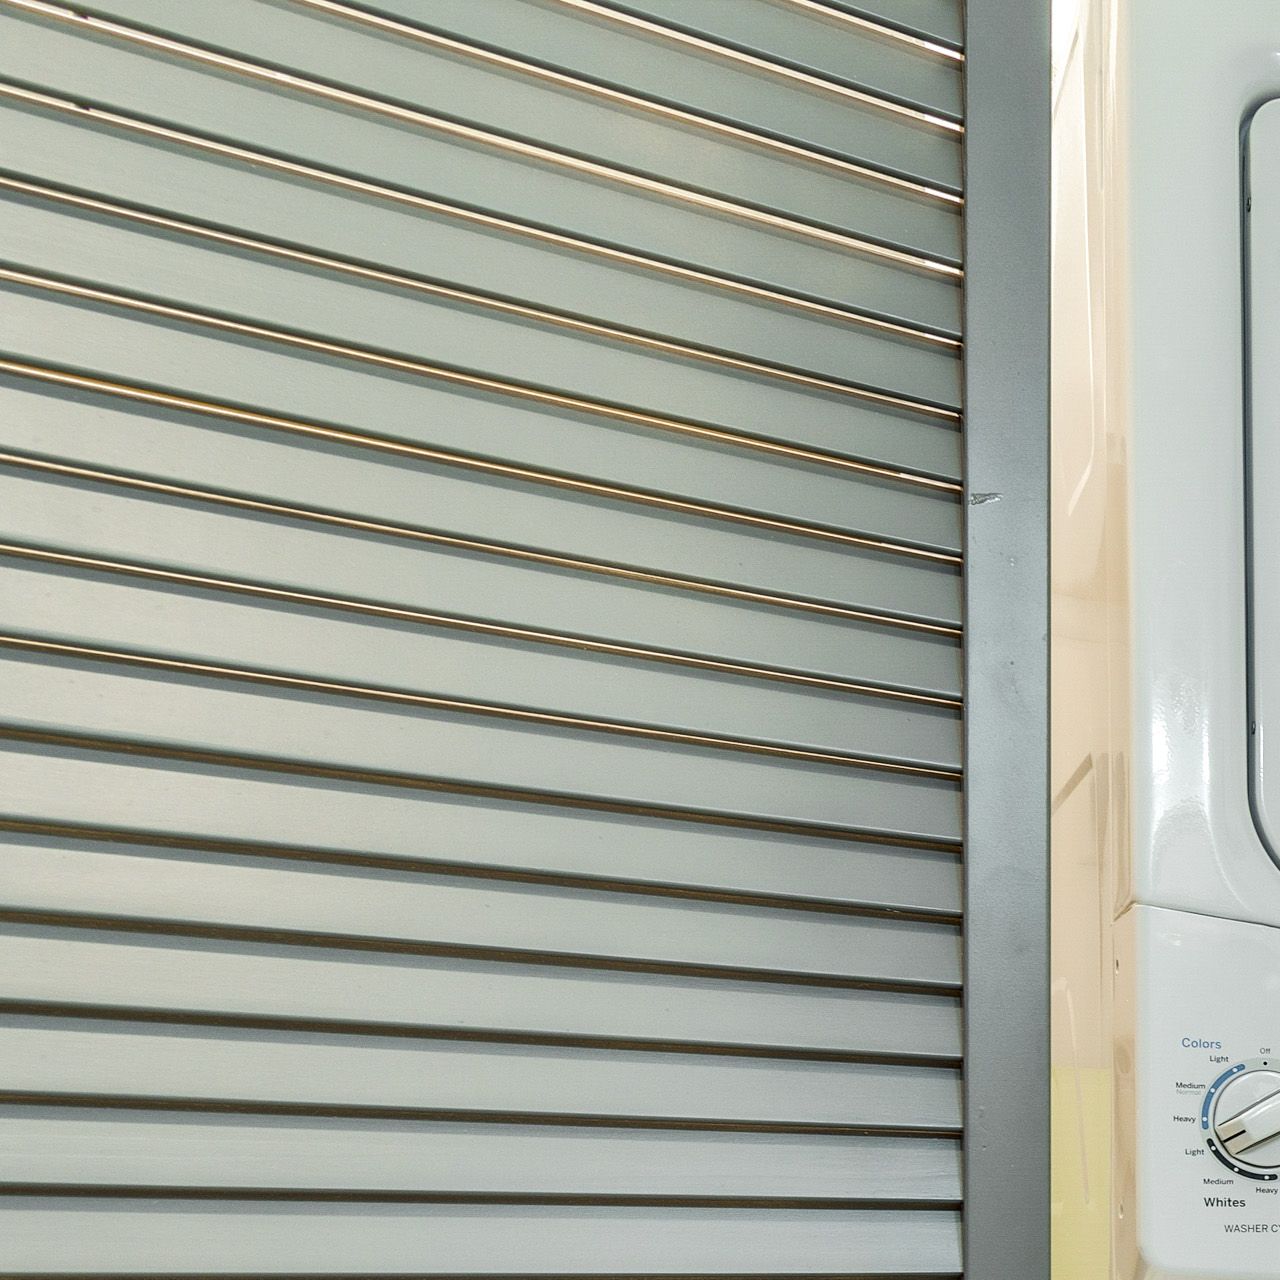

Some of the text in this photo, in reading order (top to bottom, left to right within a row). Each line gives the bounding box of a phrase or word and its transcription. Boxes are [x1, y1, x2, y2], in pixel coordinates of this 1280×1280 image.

[1182, 1038, 1222, 1049] Colors
[1204, 1197, 1246, 1207] Whites
[1224, 1224, 1268, 1233] WASHER
